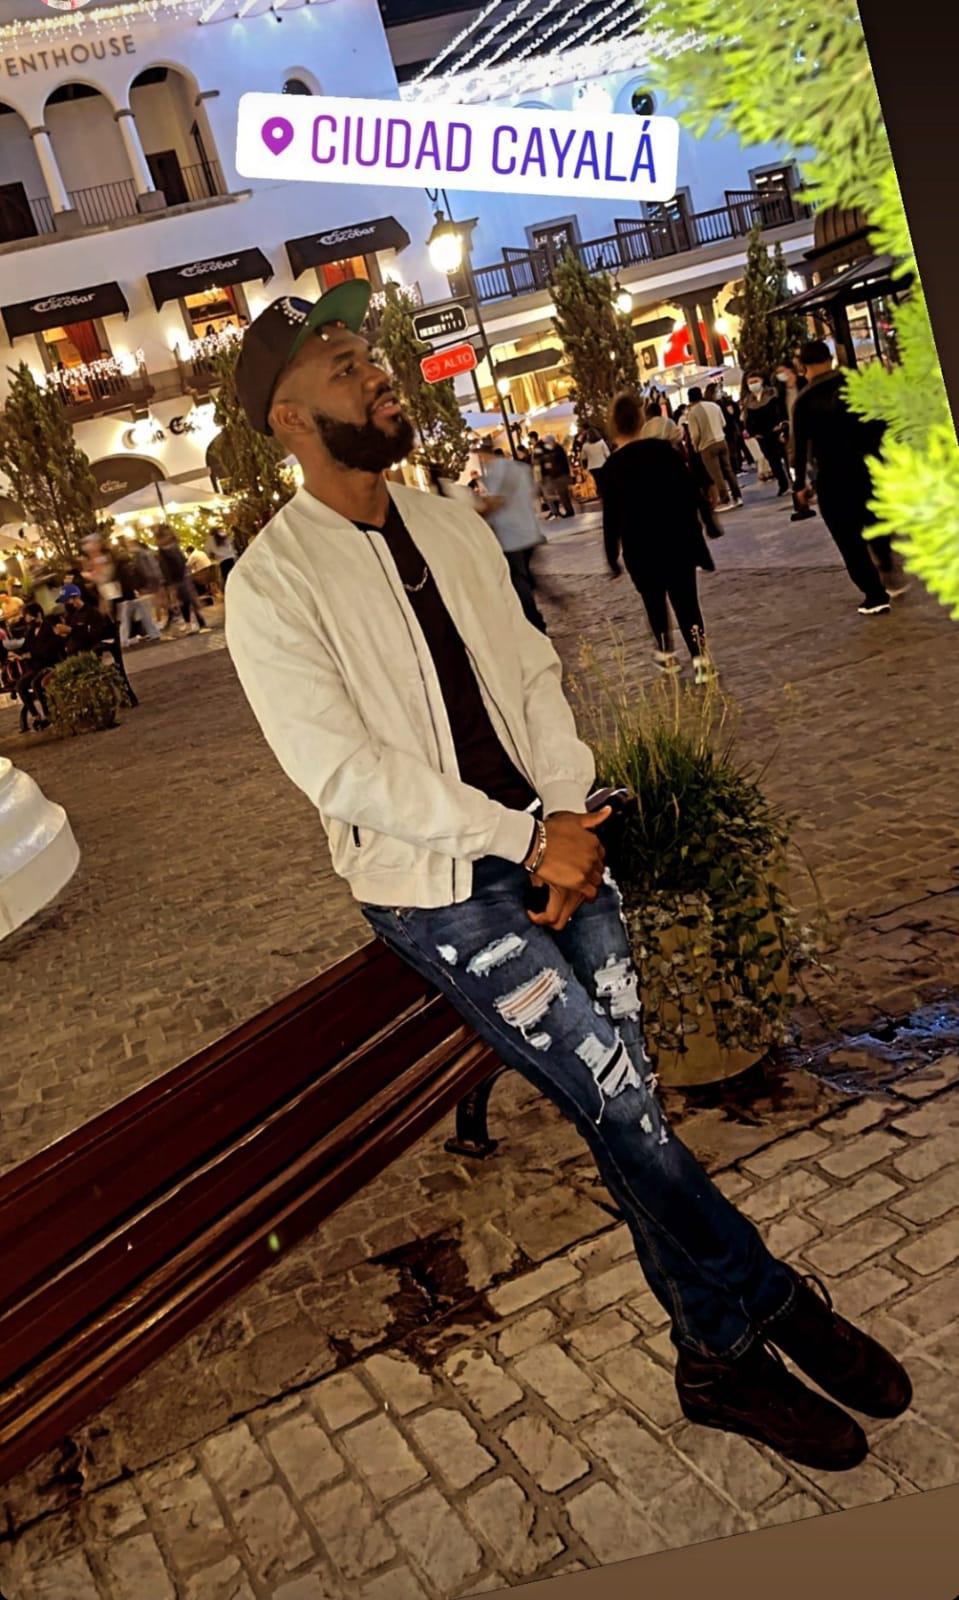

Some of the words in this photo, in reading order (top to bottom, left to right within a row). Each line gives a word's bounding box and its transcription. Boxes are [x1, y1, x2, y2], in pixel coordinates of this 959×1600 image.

[0, 35, 136, 77] ENTHOUSE
[316, 226, 376, 245] Escobar
[177, 258, 240, 278] Escobar
[30, 293, 96, 312] Escobar
[443, 353, 471, 370] ALTO
